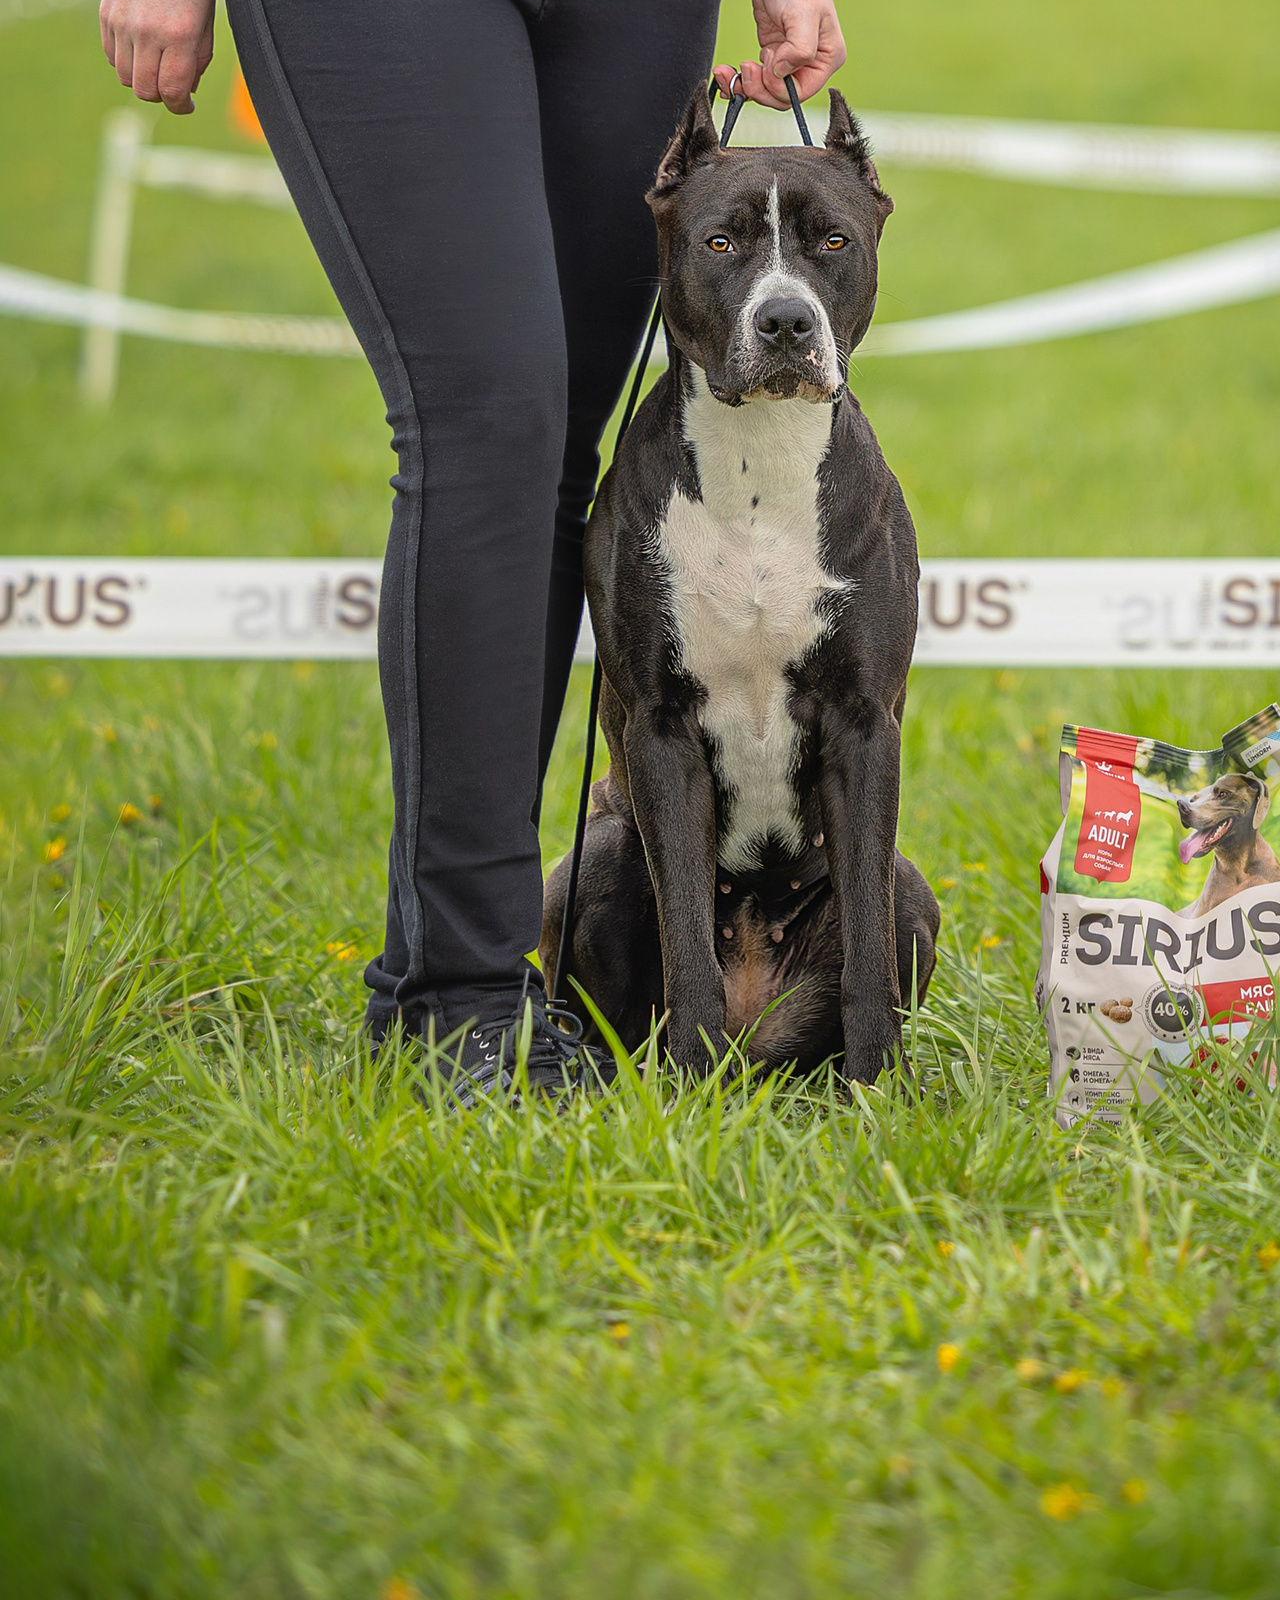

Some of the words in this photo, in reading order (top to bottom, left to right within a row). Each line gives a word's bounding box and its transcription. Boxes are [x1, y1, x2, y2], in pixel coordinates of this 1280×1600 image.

[1088, 824, 1129, 850] ADULT
[1082, 852, 1096, 860] ДЛЯ
[1096, 855, 1124, 868] ВЗРОСЛЫХ
[1093, 861, 1112, 872] СОБАК
[1060, 912, 1071, 965] PREMIUM
[1061, 996, 1071, 1014] 2
[1076, 1002, 1096, 1014] кг
